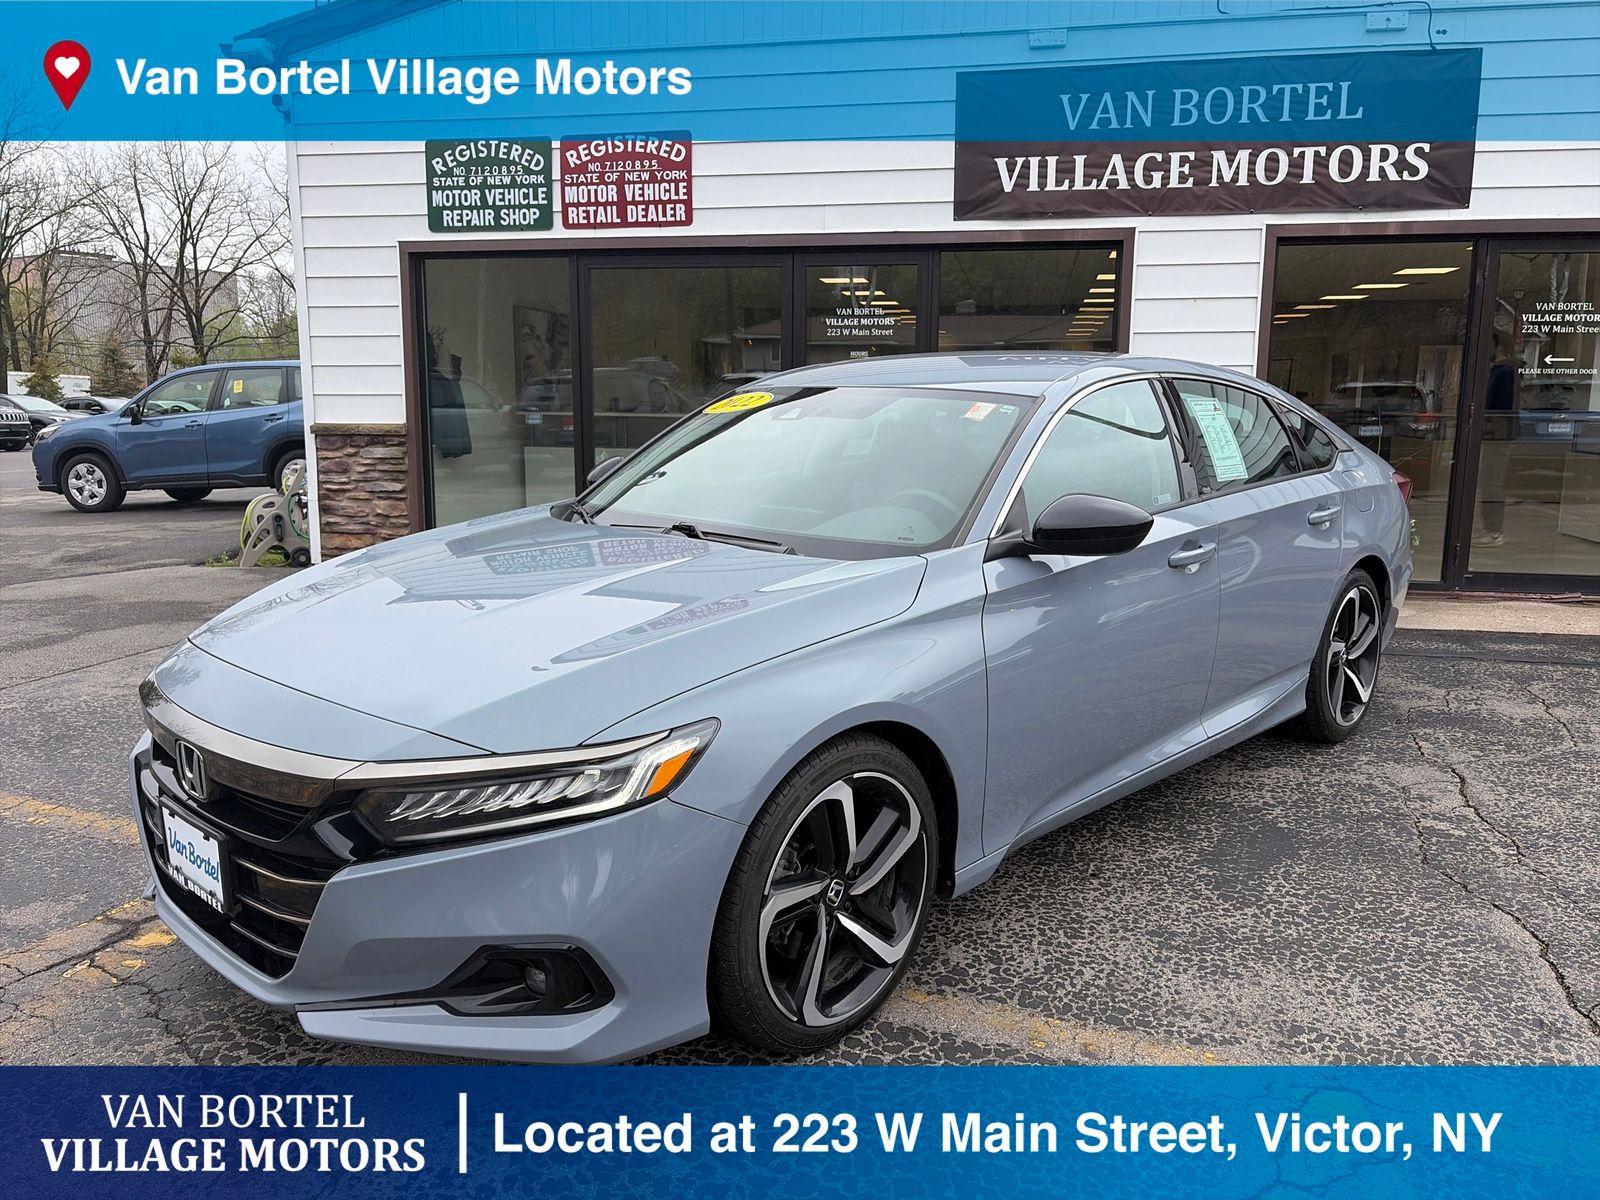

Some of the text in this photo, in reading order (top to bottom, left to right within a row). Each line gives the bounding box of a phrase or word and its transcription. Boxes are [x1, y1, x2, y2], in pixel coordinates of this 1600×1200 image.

[1060, 81, 1364, 131] VAN BORTEL
[431, 140, 545, 175] REGISTERED
[565, 135, 687, 168] REGISTERED
[453, 165, 524, 176] NO. 7120895
[588, 160, 658, 172] NO. 7120895
[993, 142, 1431, 193] VILLAGE MOTORS
[432, 174, 545, 187] STATE OF NEW YORK
[564, 170, 687, 183] STATE OF NEW YORK
[432, 187, 547, 207] MOTOR VEHICLE
[564, 182, 688, 204] MOTOR VEHICLE
[443, 207, 540, 227] REPAIR SHOP
[568, 203, 686, 224] RETAIL DEALER
[836, 307, 885, 316] VAN BORTEL
[1536, 302, 1595, 311] VAN BORTEL
[825, 317, 895, 326] VILLAGE MOTORS
[1522, 313, 1563, 322] VILLAGE
[826, 328, 894, 336] 223 W Main Street
[1521, 324, 1600, 333] 223 W Main Stree
[167, 865, 224, 914] VAN BORTEL
